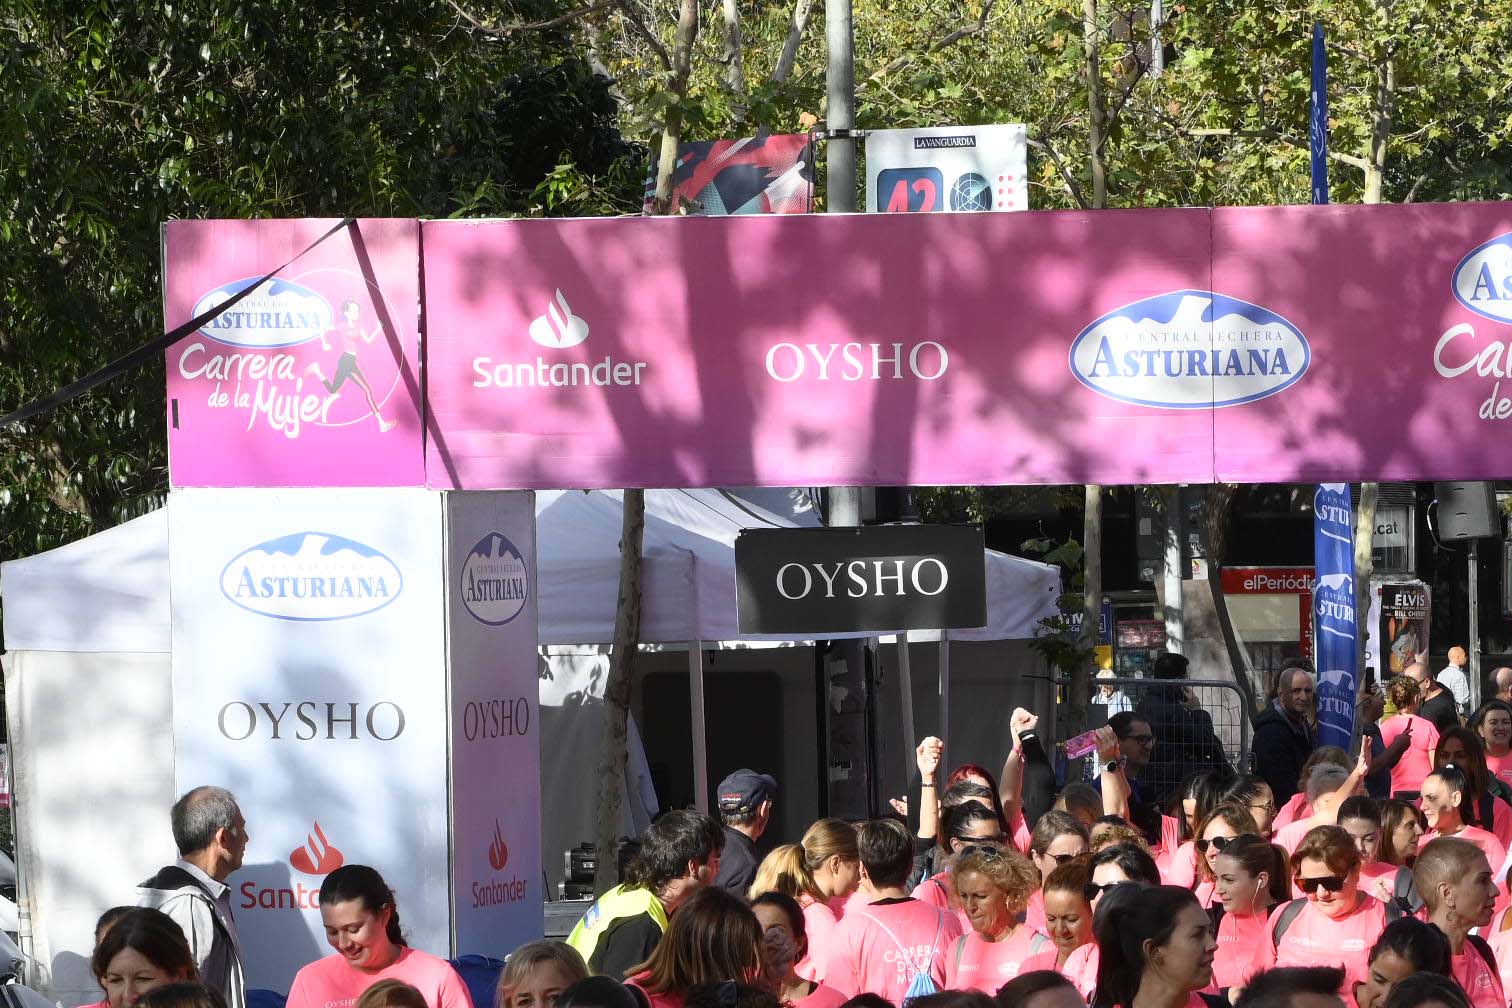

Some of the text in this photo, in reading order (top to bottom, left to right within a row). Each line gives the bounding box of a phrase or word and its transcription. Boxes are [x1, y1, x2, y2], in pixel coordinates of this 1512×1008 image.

[1208, 329, 1285, 343] LECHERA
[179, 341, 296, 381] Carrera
[473, 355, 647, 388] Santander
[765, 339, 950, 382] OYSHO
[1088, 335, 1292, 379] ASTURIANA
[208, 378, 340, 440] de la Mujer
[235, 566, 389, 599] ASTURIANA
[466, 563, 524, 602] ASTURIANA
[776, 557, 949, 600] OYSHO
[1394, 593, 1425, 607] ELVIS
[217, 701, 406, 741] OYSHO
[464, 697, 530, 743] OYSHO
[472, 878, 527, 910] Santander
